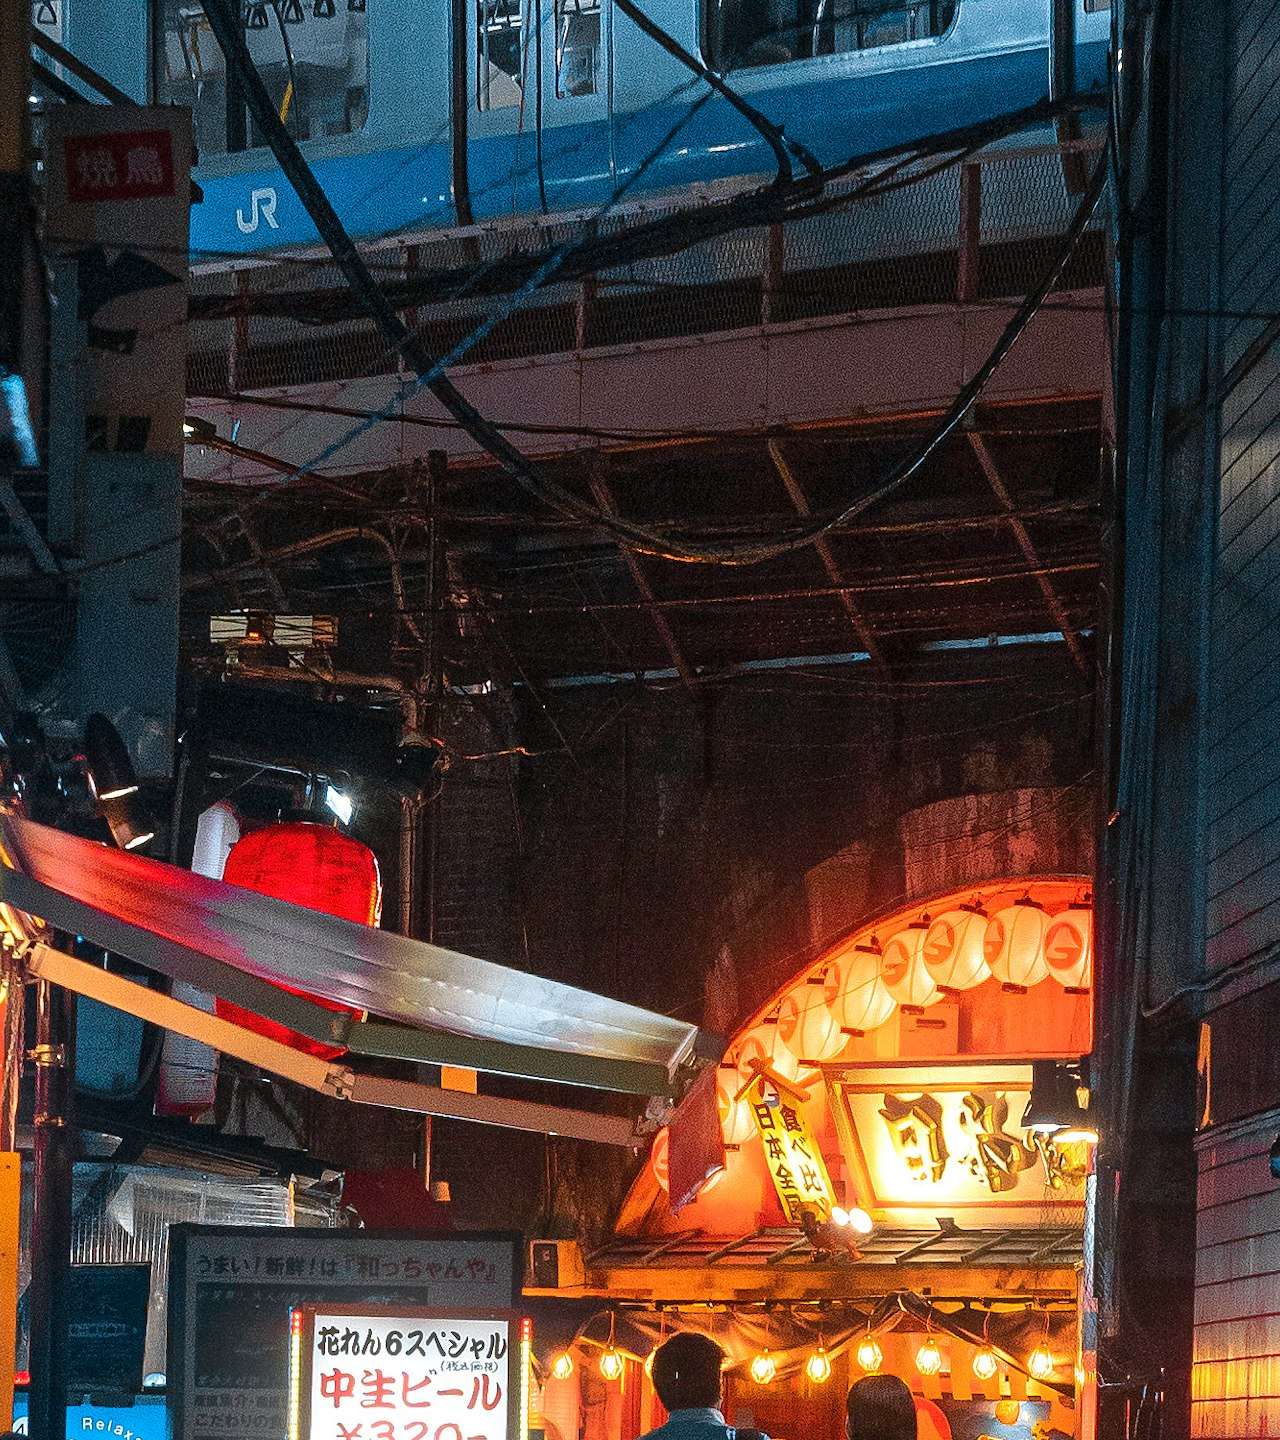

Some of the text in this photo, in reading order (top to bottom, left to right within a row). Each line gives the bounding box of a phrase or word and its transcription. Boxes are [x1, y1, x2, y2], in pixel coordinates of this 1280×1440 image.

[235, 187, 282, 234] JR
[320, 1367, 502, 1411] 中生ビール
